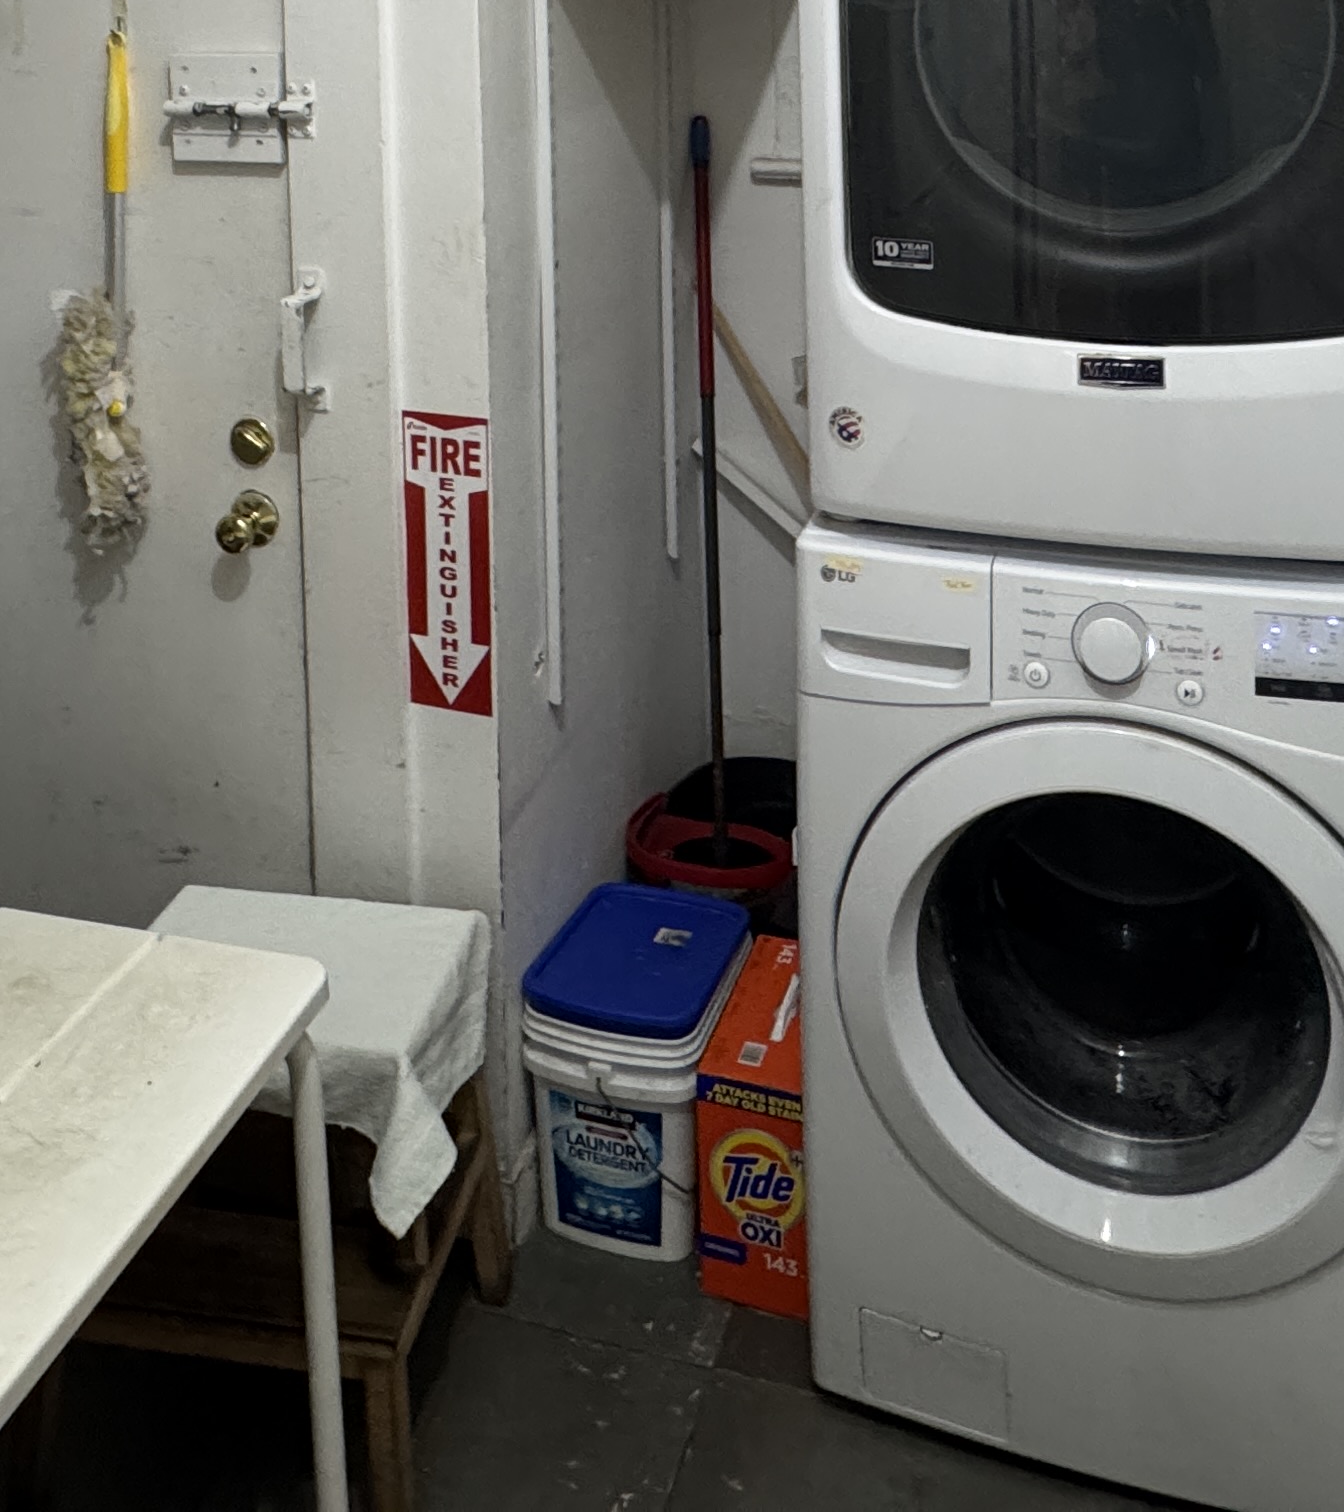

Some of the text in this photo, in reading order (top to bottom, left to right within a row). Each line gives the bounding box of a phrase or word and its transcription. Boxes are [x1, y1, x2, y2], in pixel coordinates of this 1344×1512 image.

[875, 239, 929, 257] 10 YEAR
[1083, 360, 1160, 382] MAYTAG
[410, 434, 481, 477] FIRE
[437, 476, 460, 689] EXTINGUISHER
[776, 943, 798, 965] 143
[706, 1090, 714, 1101] 7
[715, 1092, 739, 1107] DAY
[741, 1099, 766, 1114] OLD
[712, 1083, 801, 1112] ATTACKS EVEN
[577, 1102, 635, 1123] KIRKLAND
[566, 1128, 648, 1160] LAUNDRY
[568, 1144, 646, 1173] DETERGENT
[722, 1155, 796, 1203] Tide
[746, 1212, 781, 1228] ULTRA
[741, 1222, 782, 1249] OXI
[763, 1252, 799, 1277] 143
